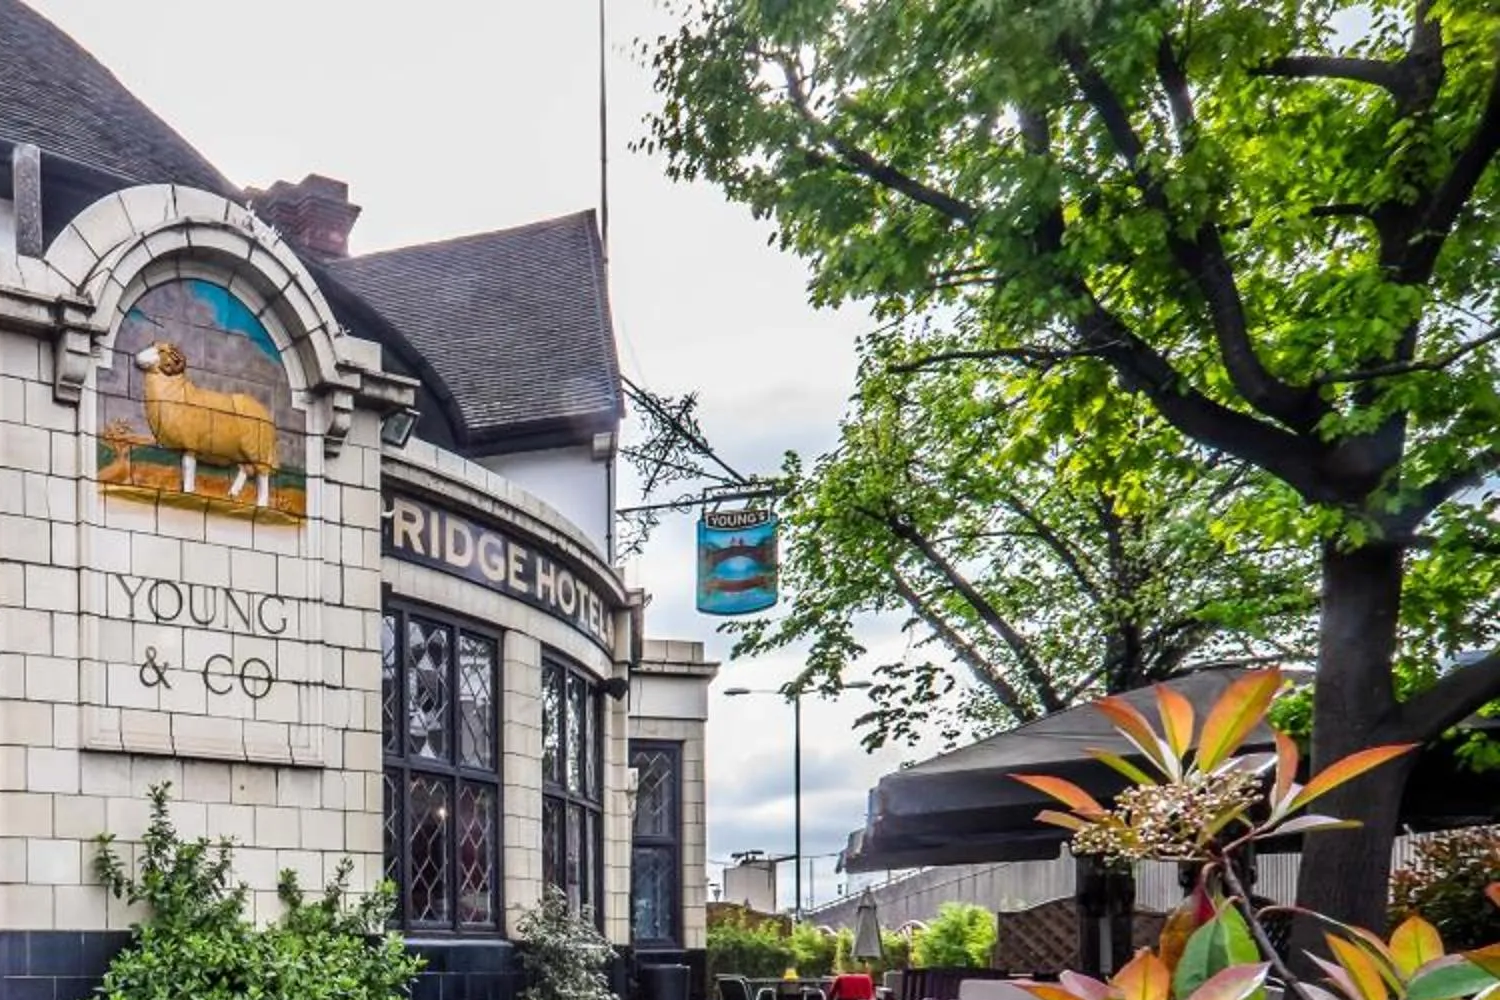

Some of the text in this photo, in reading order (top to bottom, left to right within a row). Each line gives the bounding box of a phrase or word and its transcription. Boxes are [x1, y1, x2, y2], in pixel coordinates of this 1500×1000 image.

[393, 497, 608, 644] RIDGE HOTEL
[116, 574, 287, 635] YOUNG
[139, 645, 273, 698] & CO
